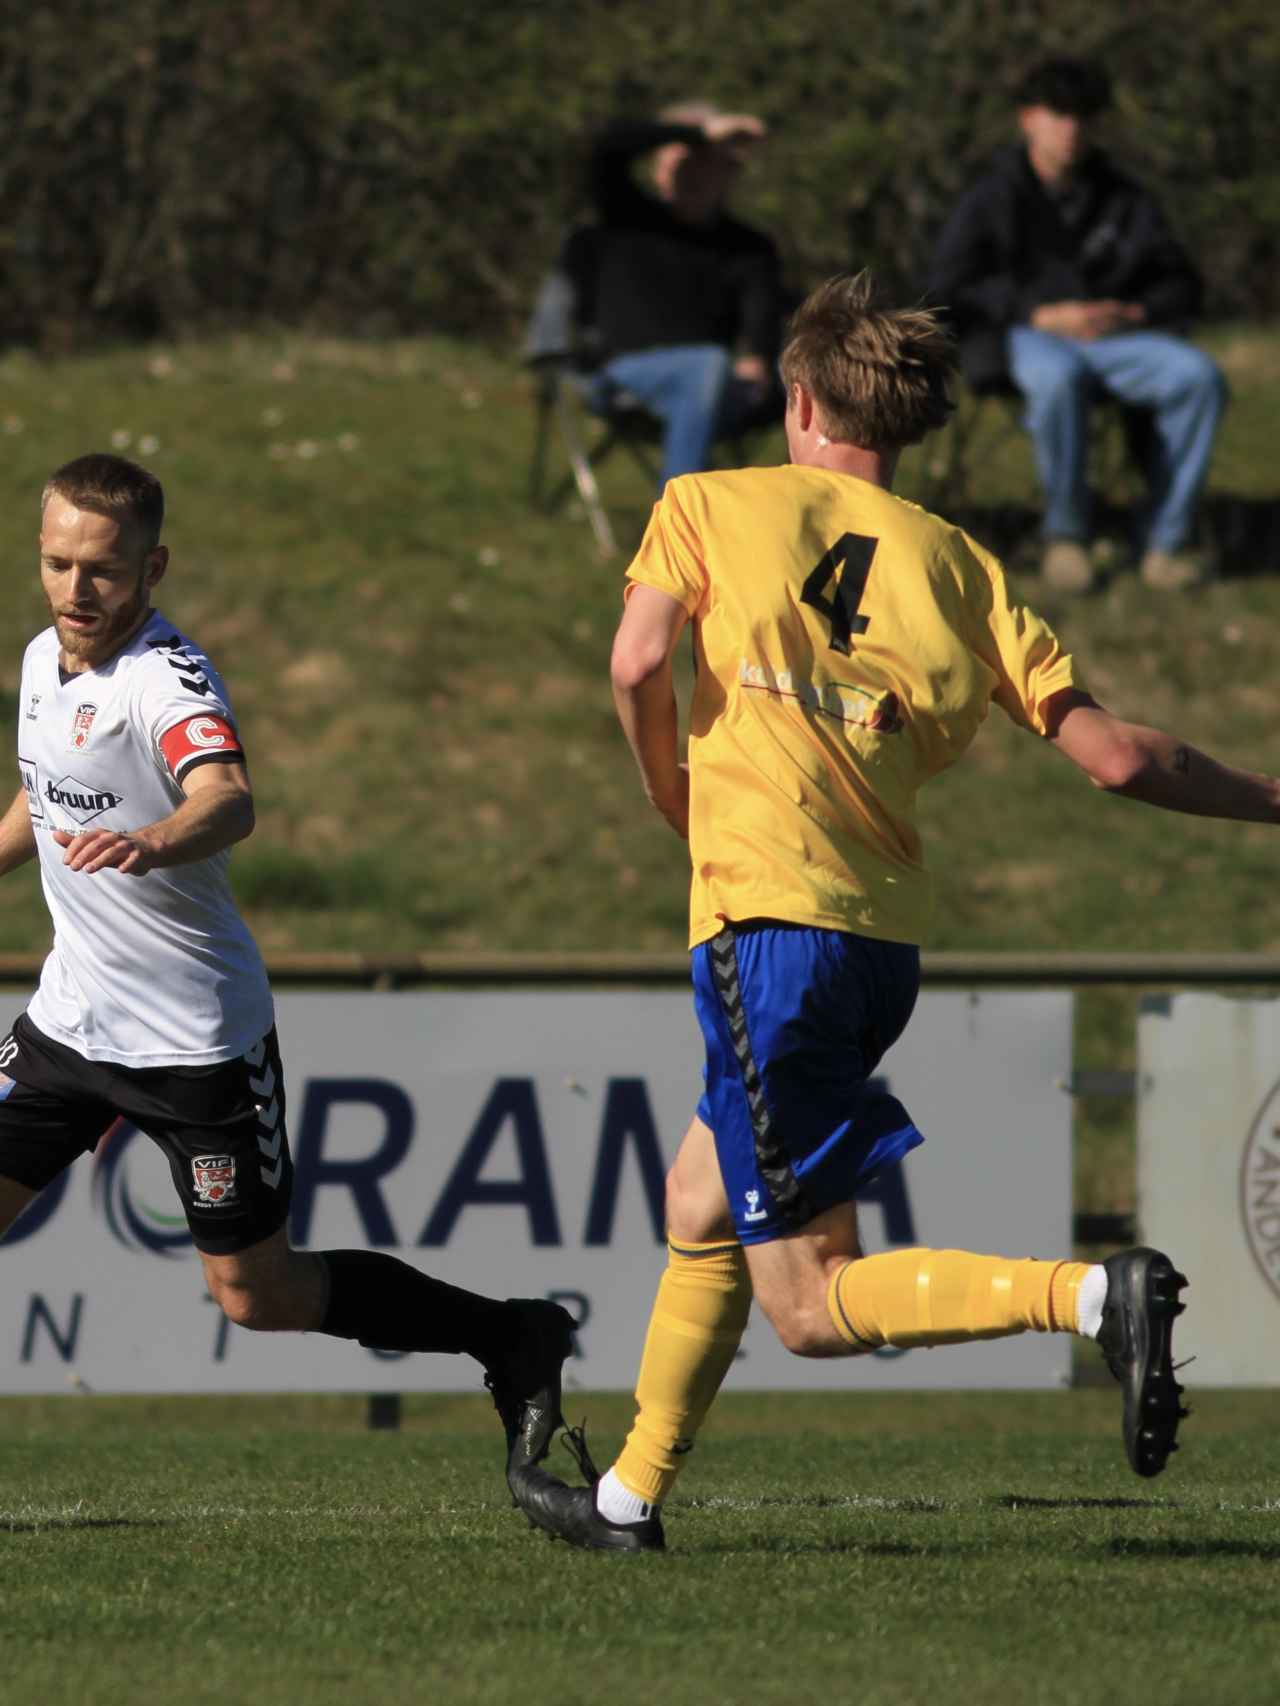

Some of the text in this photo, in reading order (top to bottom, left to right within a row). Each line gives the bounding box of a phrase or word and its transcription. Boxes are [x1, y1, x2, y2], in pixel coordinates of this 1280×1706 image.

[799, 531, 879, 657] 4
[185, 717, 225, 748] C
[47, 780, 117, 811] bruun
